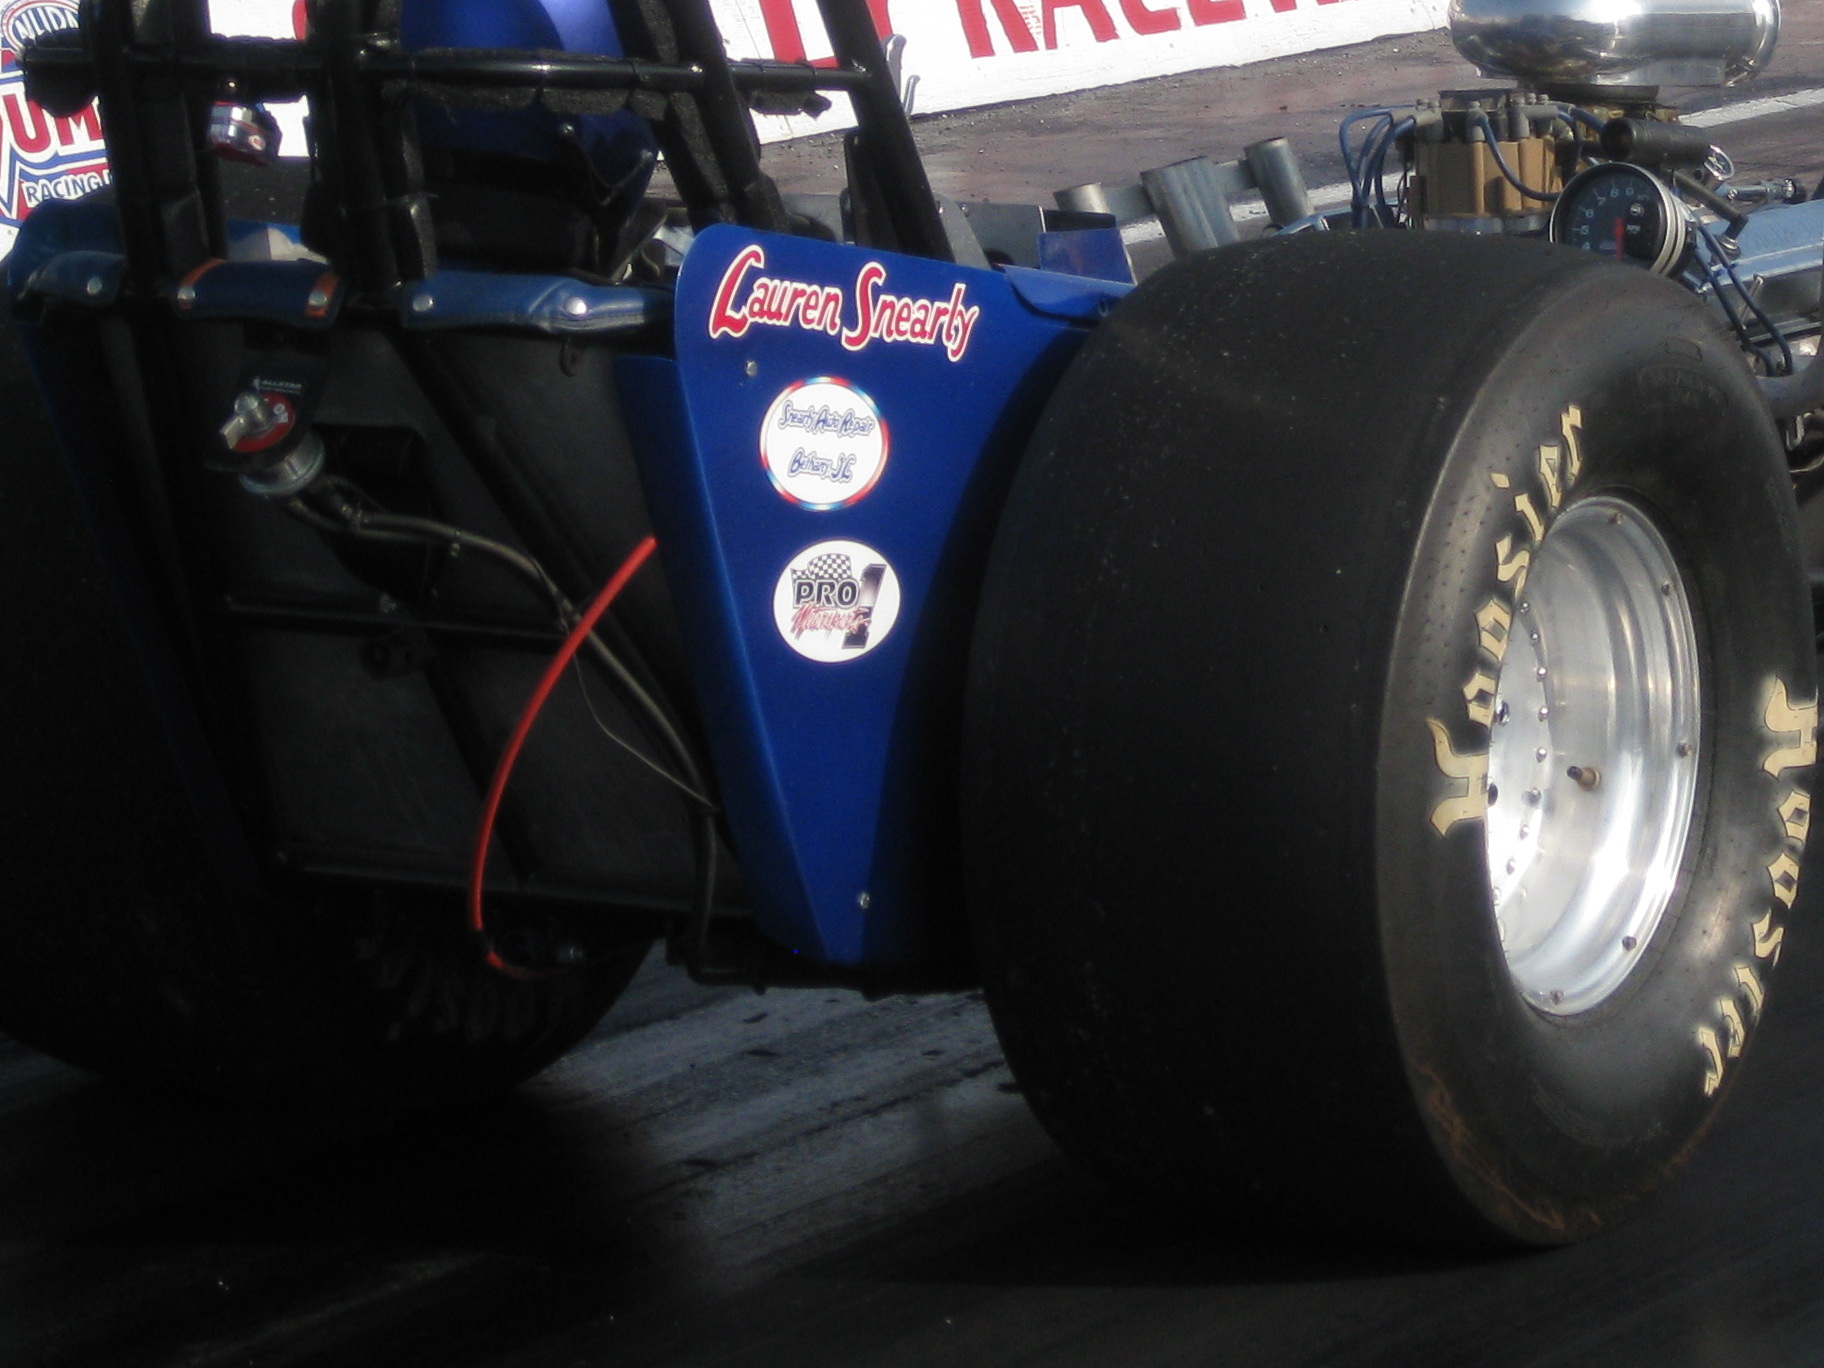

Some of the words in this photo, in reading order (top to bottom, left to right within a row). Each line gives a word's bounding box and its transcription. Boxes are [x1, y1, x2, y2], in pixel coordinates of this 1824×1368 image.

[710, 244, 842, 340] Lauren
[841, 261, 980, 363] Snearly
[794, 578, 859, 609] PRO
